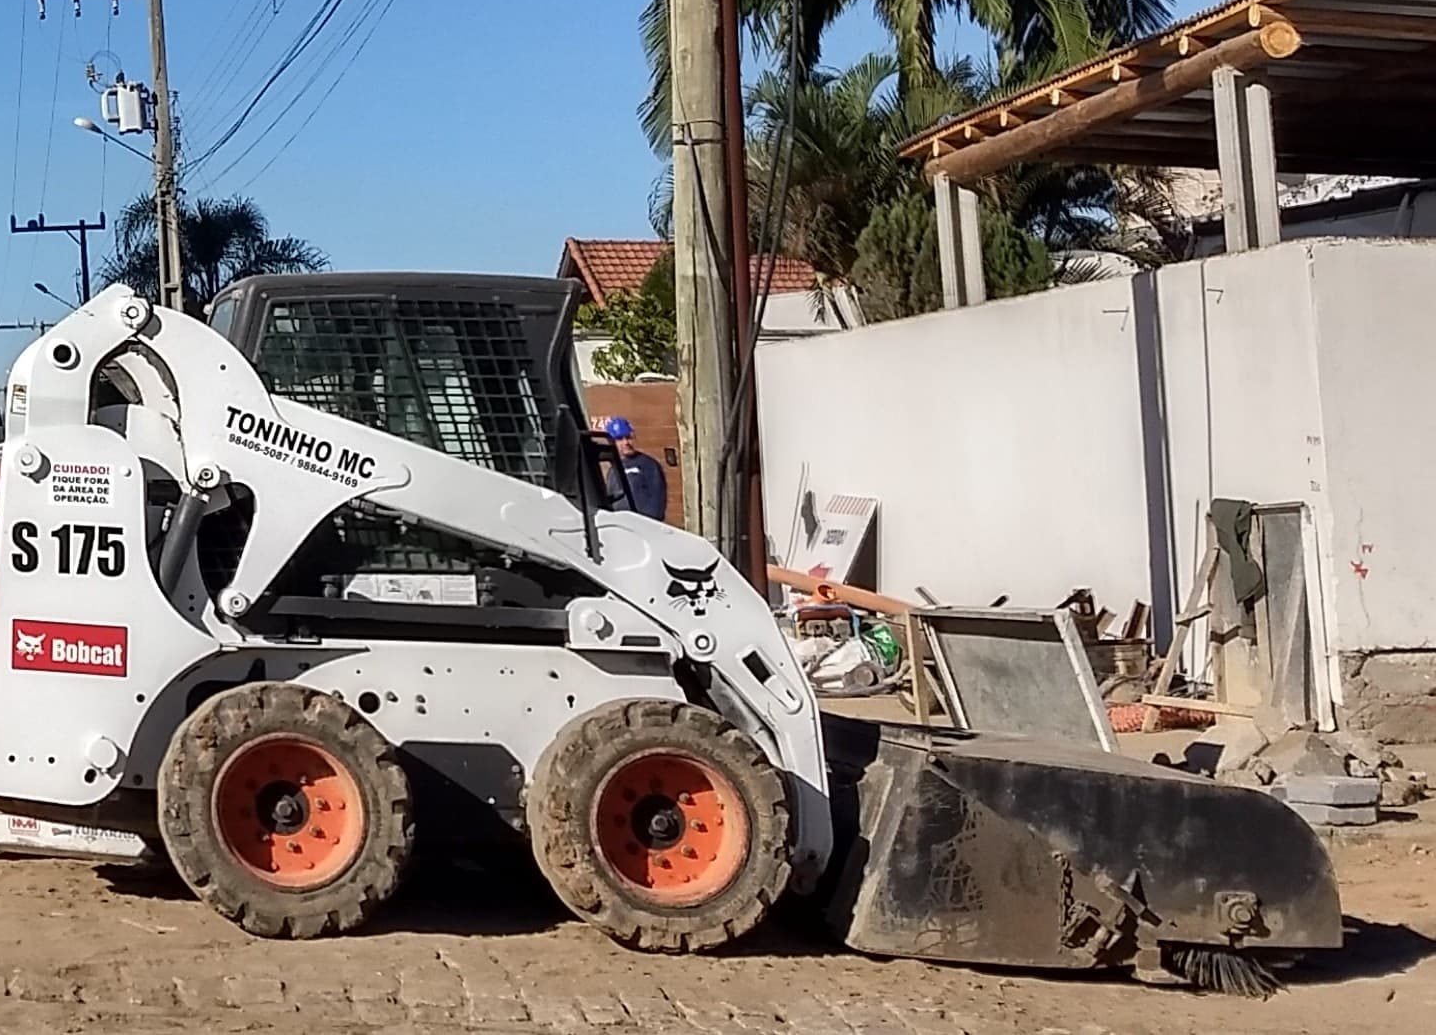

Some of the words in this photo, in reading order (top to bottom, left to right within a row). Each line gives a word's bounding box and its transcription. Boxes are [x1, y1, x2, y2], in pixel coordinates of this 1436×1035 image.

[226, 405, 332, 462] TONINHO
[337, 449, 375, 479] MC
[53, 464, 110, 475] CUIDADO!
[52, 476, 81, 484] FIQUE
[84, 477, 110, 485] FORA
[52, 485, 65, 493] DA
[68, 484, 94, 494] ÁREA
[96, 486, 109, 494] DE
[53, 494, 109, 504] OPERAÇÃO.
[12, 521, 39, 573] S
[51, 524, 125, 577] 175
[51, 639, 123, 666] Bobcat
